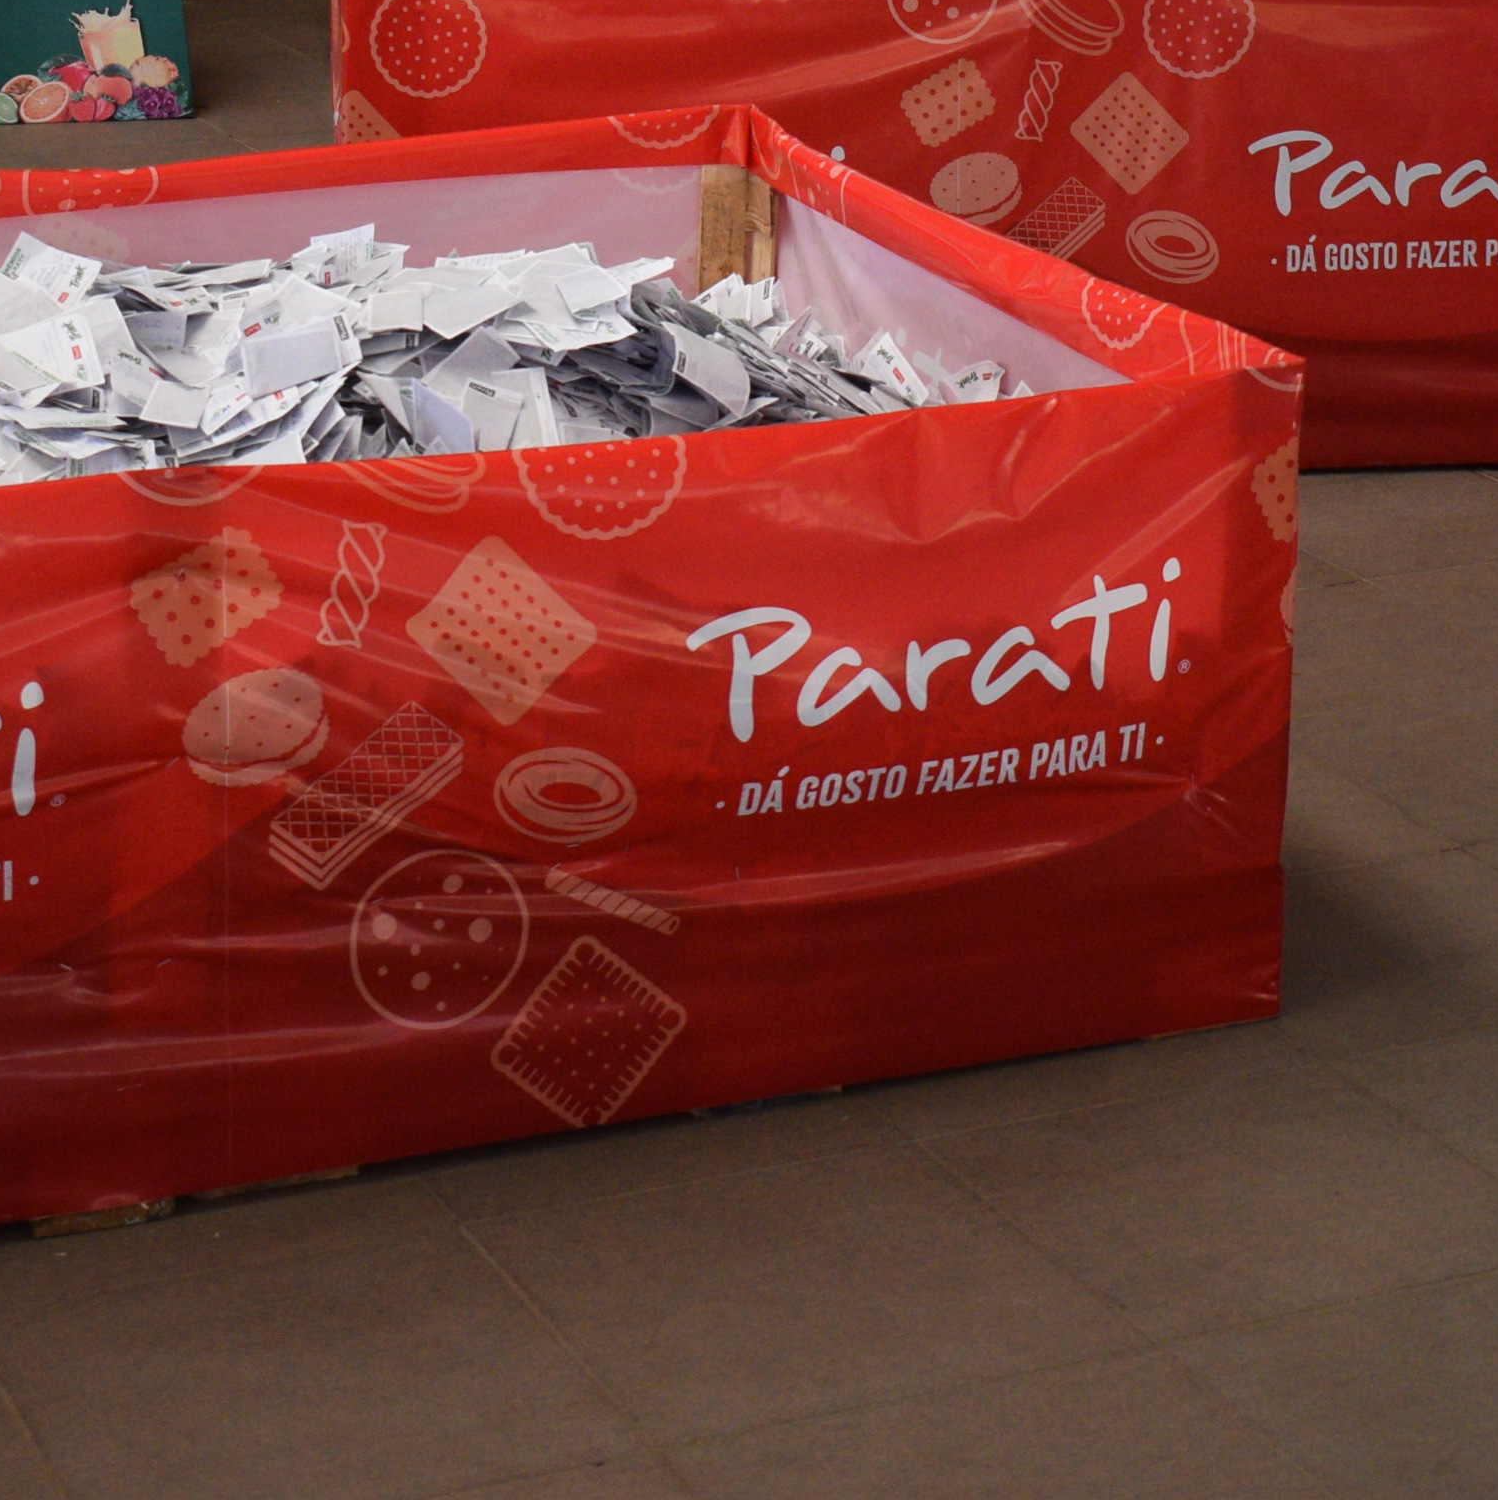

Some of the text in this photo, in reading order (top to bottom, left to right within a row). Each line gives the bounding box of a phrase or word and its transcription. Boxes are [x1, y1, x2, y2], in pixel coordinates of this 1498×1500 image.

[1286, 235, 1317, 273] DÁ
[1324, 242, 1398, 271] GOSTO
[1406, 240, 1477, 270] FAZER
[686, 557, 1181, 743] Parati
[738, 722, 1147, 816] DÁ GOSTO FAZER PARA TI
